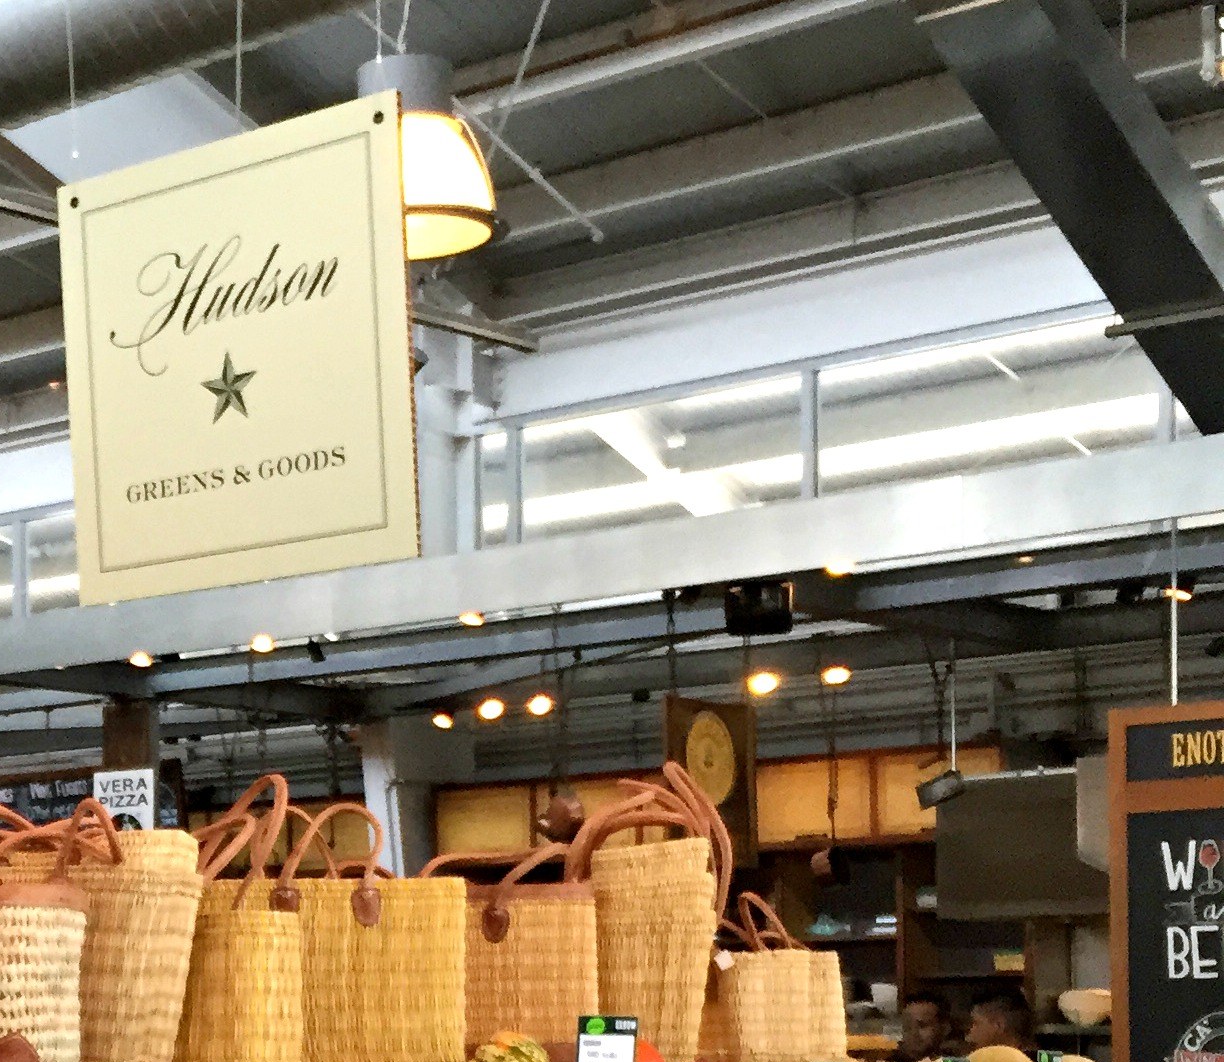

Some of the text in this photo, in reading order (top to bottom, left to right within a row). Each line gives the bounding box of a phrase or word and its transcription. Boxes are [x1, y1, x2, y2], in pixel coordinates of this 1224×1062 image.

[110, 234, 339, 377] Hudson
[126, 446, 347, 504] GREENS & GOODS
[99, 778, 148, 793] VERA
[99, 793, 148, 808] PIZZA
